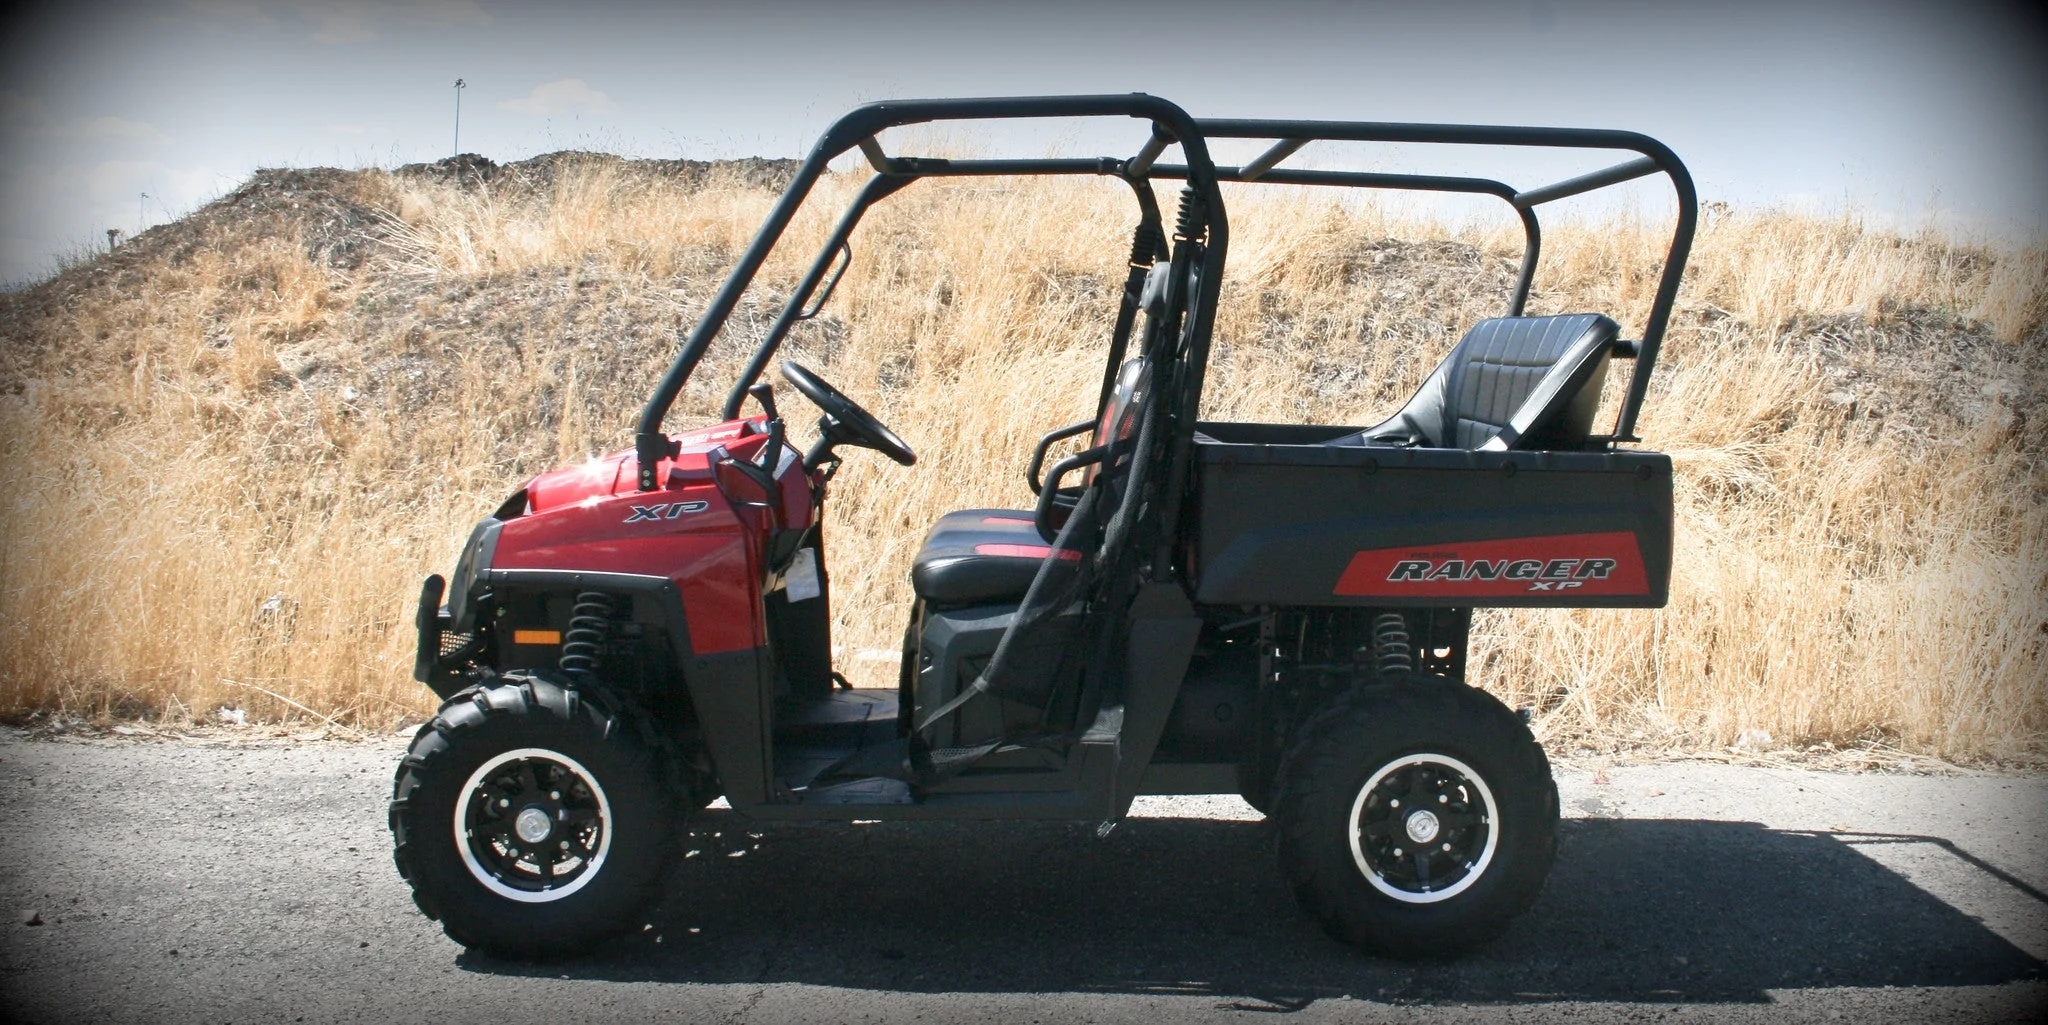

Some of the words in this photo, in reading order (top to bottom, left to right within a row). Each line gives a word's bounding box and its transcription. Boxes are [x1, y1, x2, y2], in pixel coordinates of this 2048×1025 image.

[622, 500, 709, 523] XP
[1386, 558, 1617, 581] RANGER
[1528, 581, 1583, 591] XP
